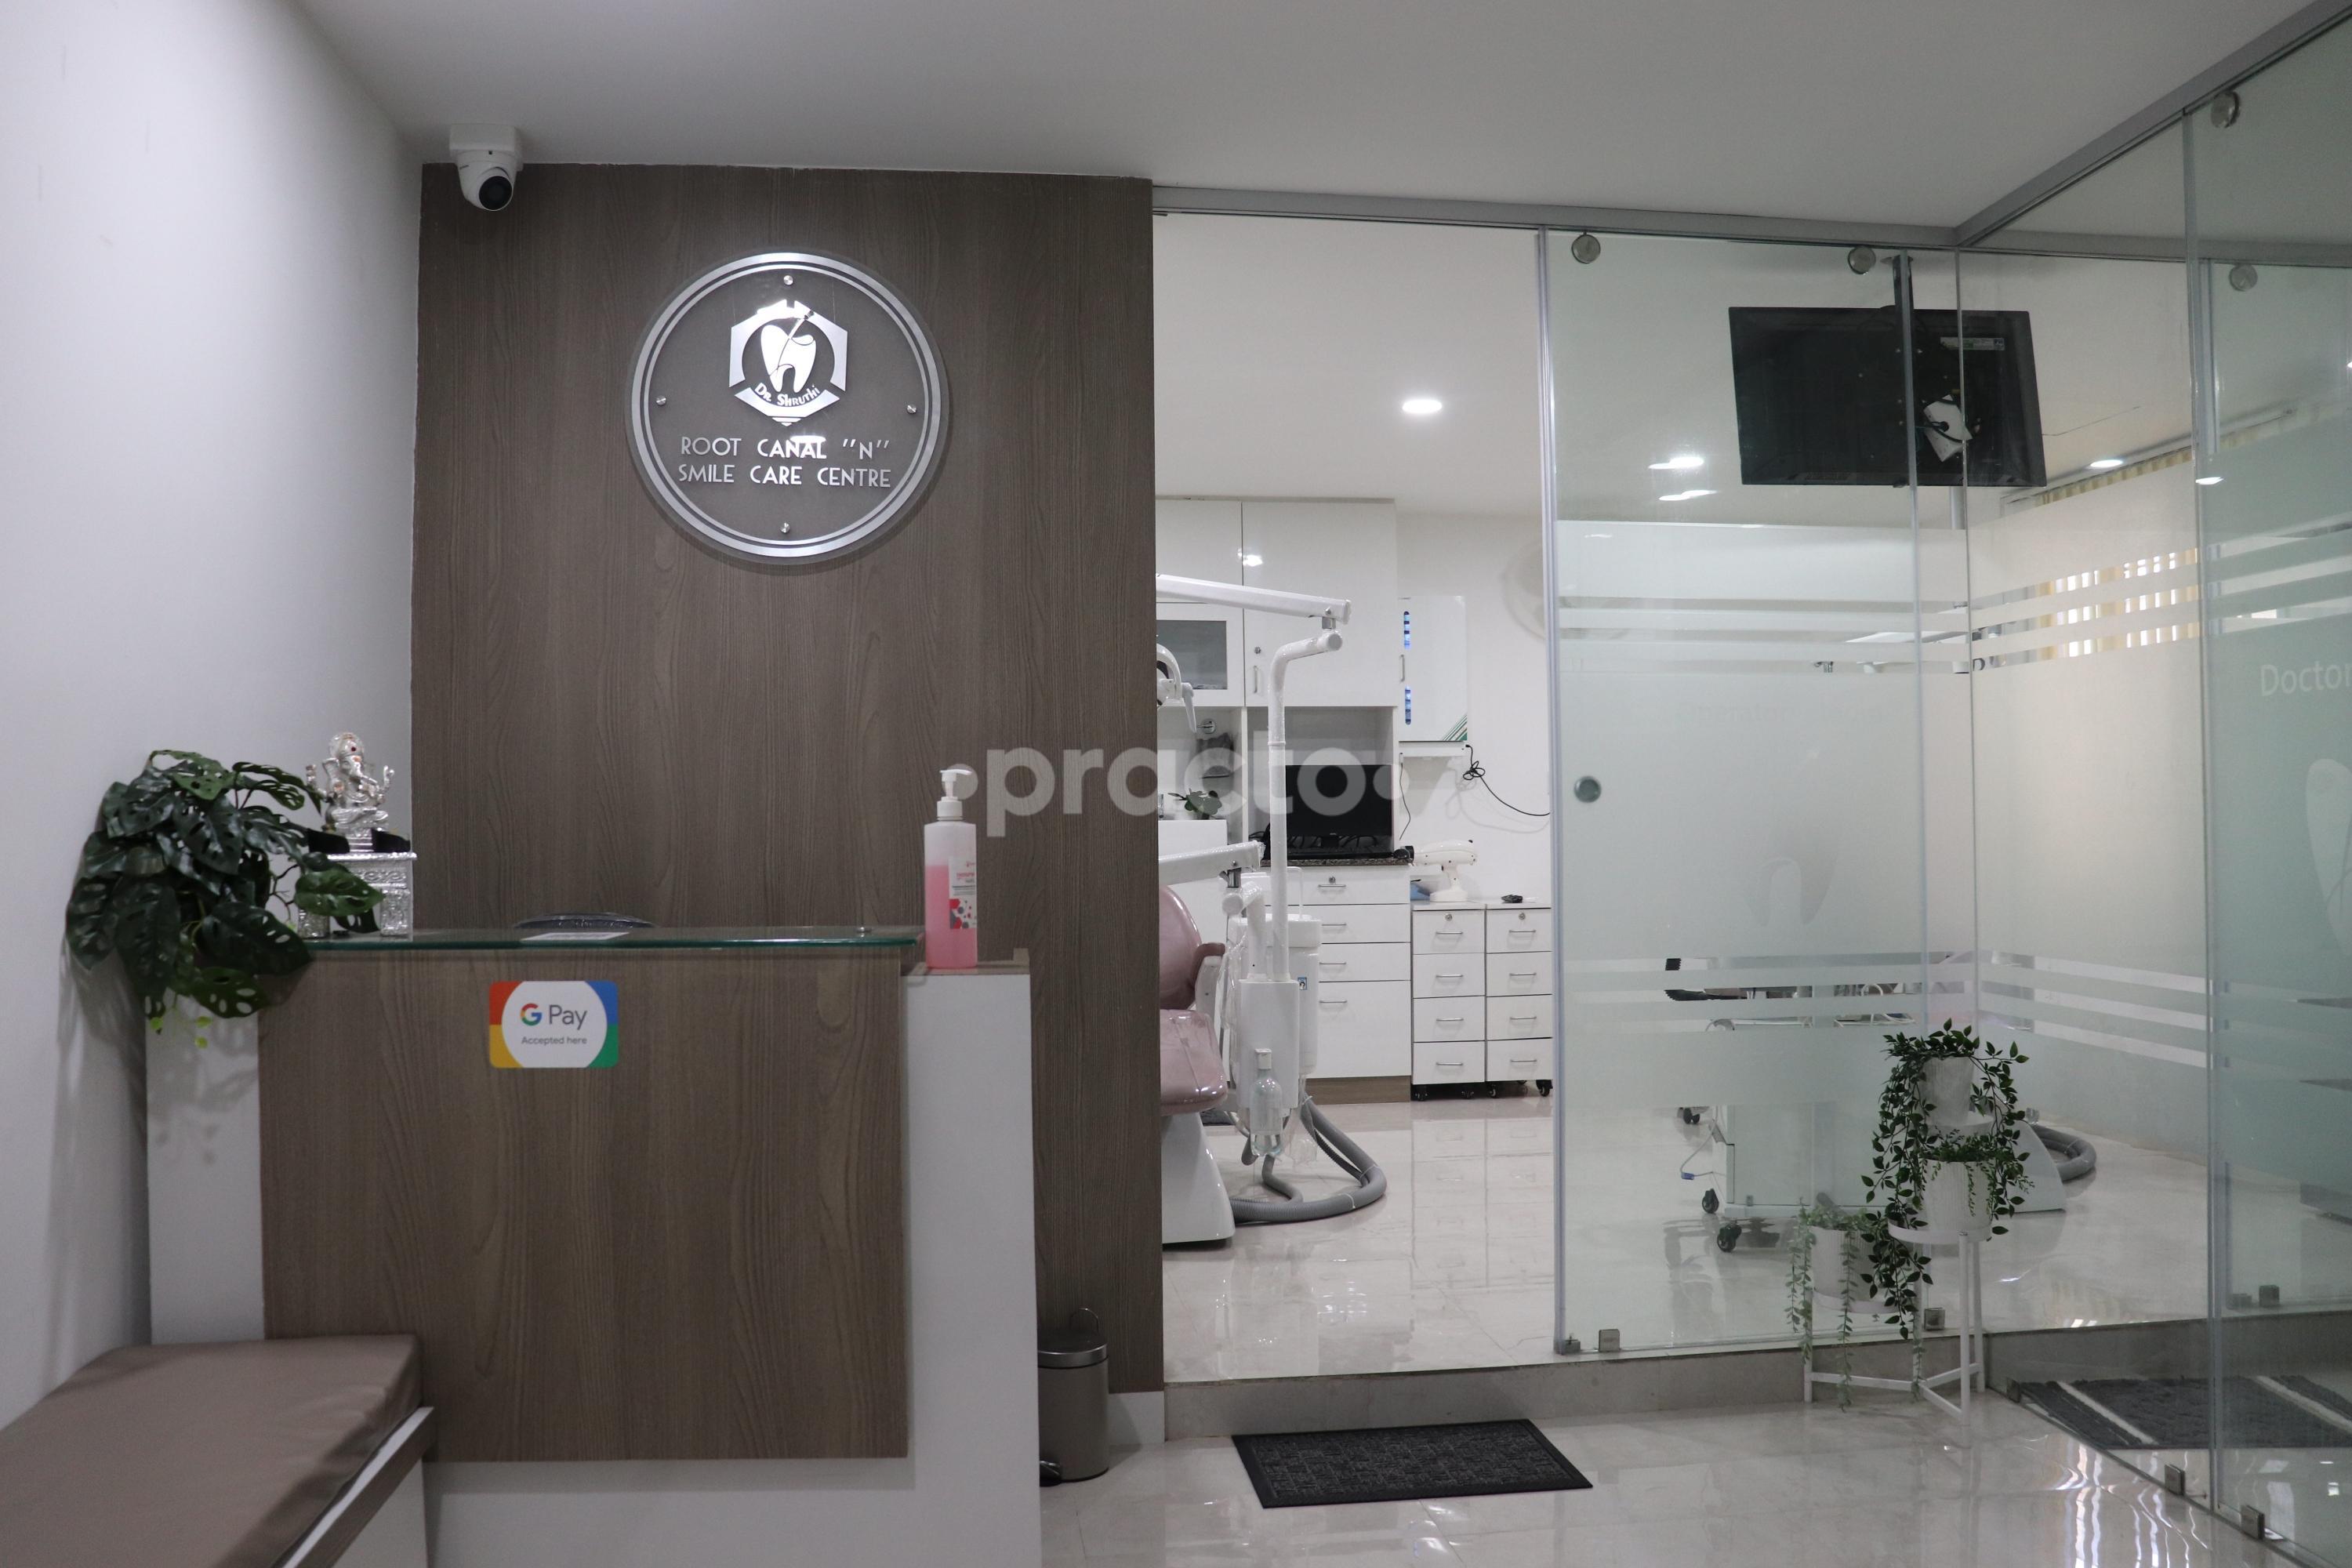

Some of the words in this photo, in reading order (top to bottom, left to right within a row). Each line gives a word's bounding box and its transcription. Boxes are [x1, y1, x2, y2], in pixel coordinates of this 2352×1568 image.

[681, 436, 742, 456] ROOT
[757, 437, 827, 459] CANAL
[678, 463, 735, 483] SMILE
[750, 465, 803, 485] CARE
[817, 466, 891, 488] CENTRE
[549, 1004, 588, 1031] Pay
[521, 1036, 564, 1046] Accepted
[567, 1036, 587, 1045] here
